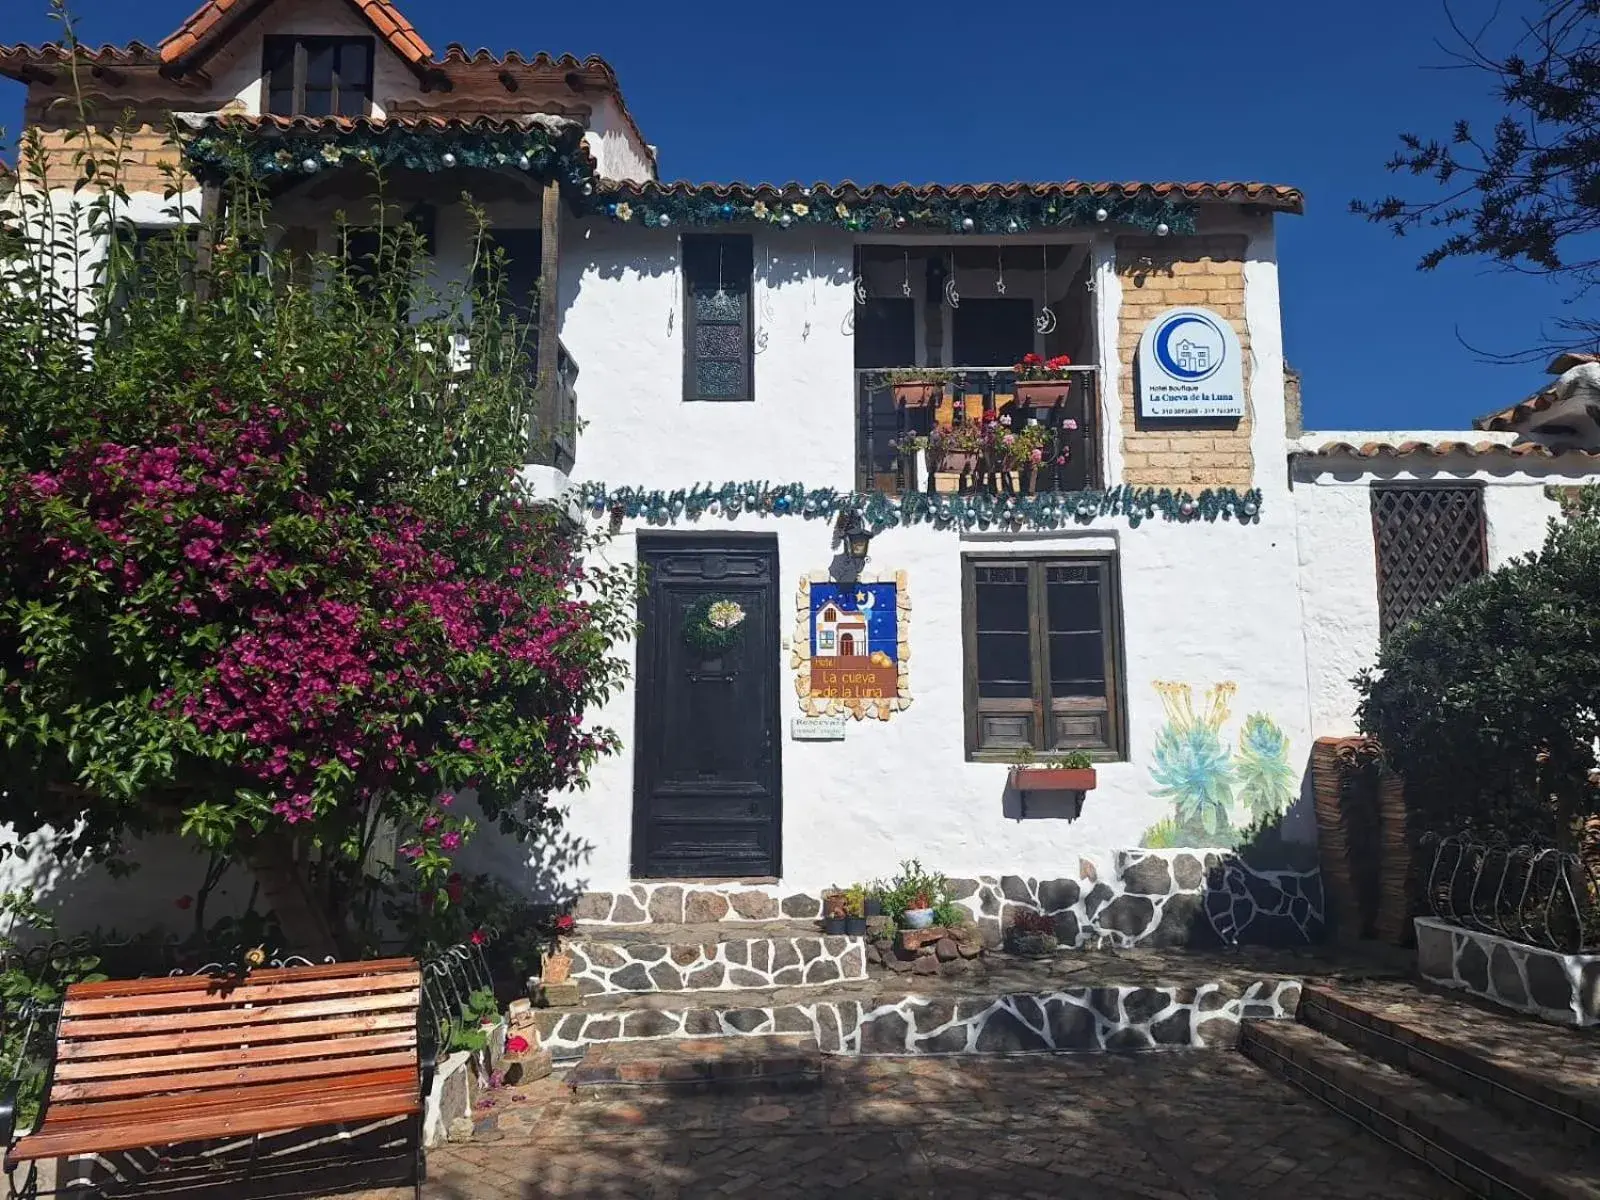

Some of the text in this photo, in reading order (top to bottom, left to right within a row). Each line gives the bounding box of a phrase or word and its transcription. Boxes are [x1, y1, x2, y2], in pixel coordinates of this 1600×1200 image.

[1169, 385, 1199, 393] Boutique
[1150, 392, 1233, 401] La Cueva de la Luna
[822, 671, 876, 684] La cueva
[823, 685, 837, 698] de
[842, 686, 852, 698] la
